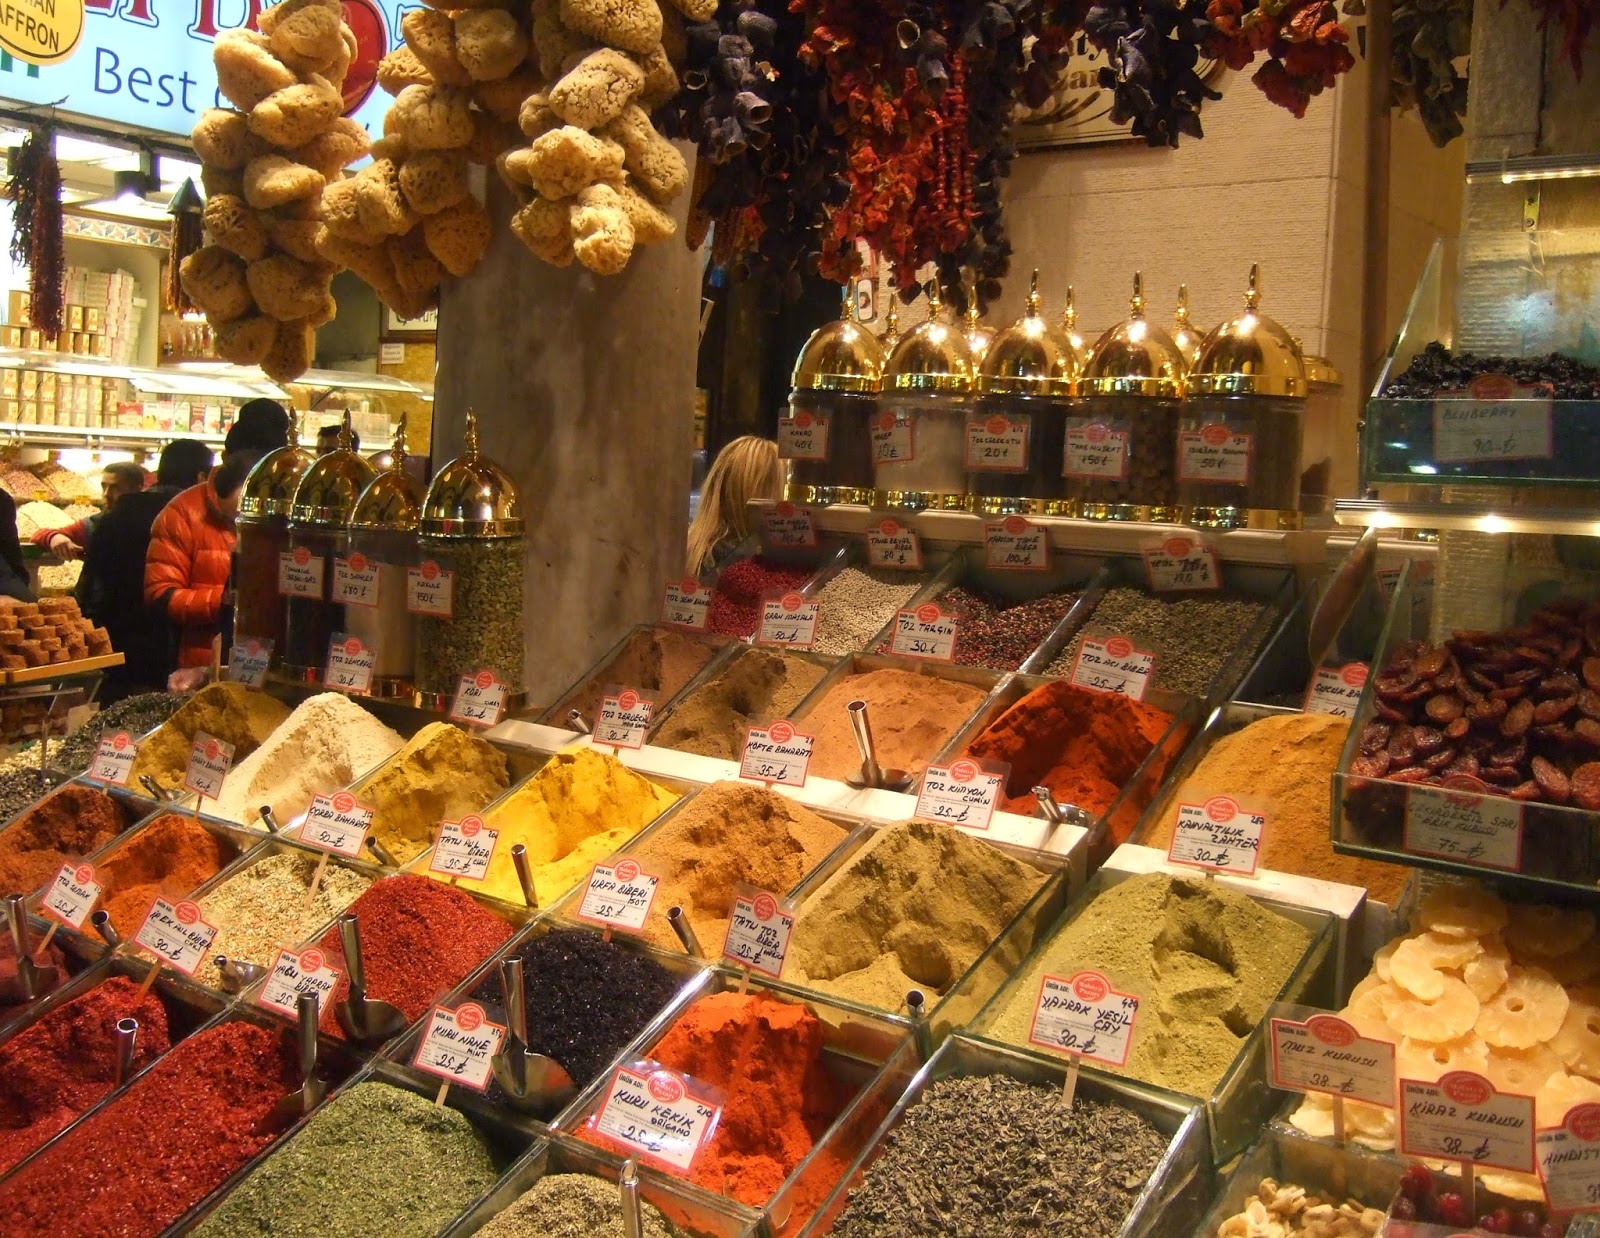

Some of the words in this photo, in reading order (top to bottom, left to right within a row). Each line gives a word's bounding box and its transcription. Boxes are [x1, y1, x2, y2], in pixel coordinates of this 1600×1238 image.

[94, 46, 197, 114] Best
[899, 620, 915, 631] TOZ
[1082, 653, 1101, 663] TOZ
[927, 781, 945, 791] TOZ
[591, 879, 617, 890] URFA
[1042, 995, 1092, 1016] YAPRAK
[434, 1025, 459, 1040] KURU
[458, 1035, 491, 1050] NANE
[466, 1047, 487, 1058] MINT
[1280, 1040, 1316, 1054] MUZ
[1323, 1050, 1378, 1067] KURUSU
[613, 1089, 650, 1109] KURU
[1465, 1111, 1525, 1128] KURUSU
